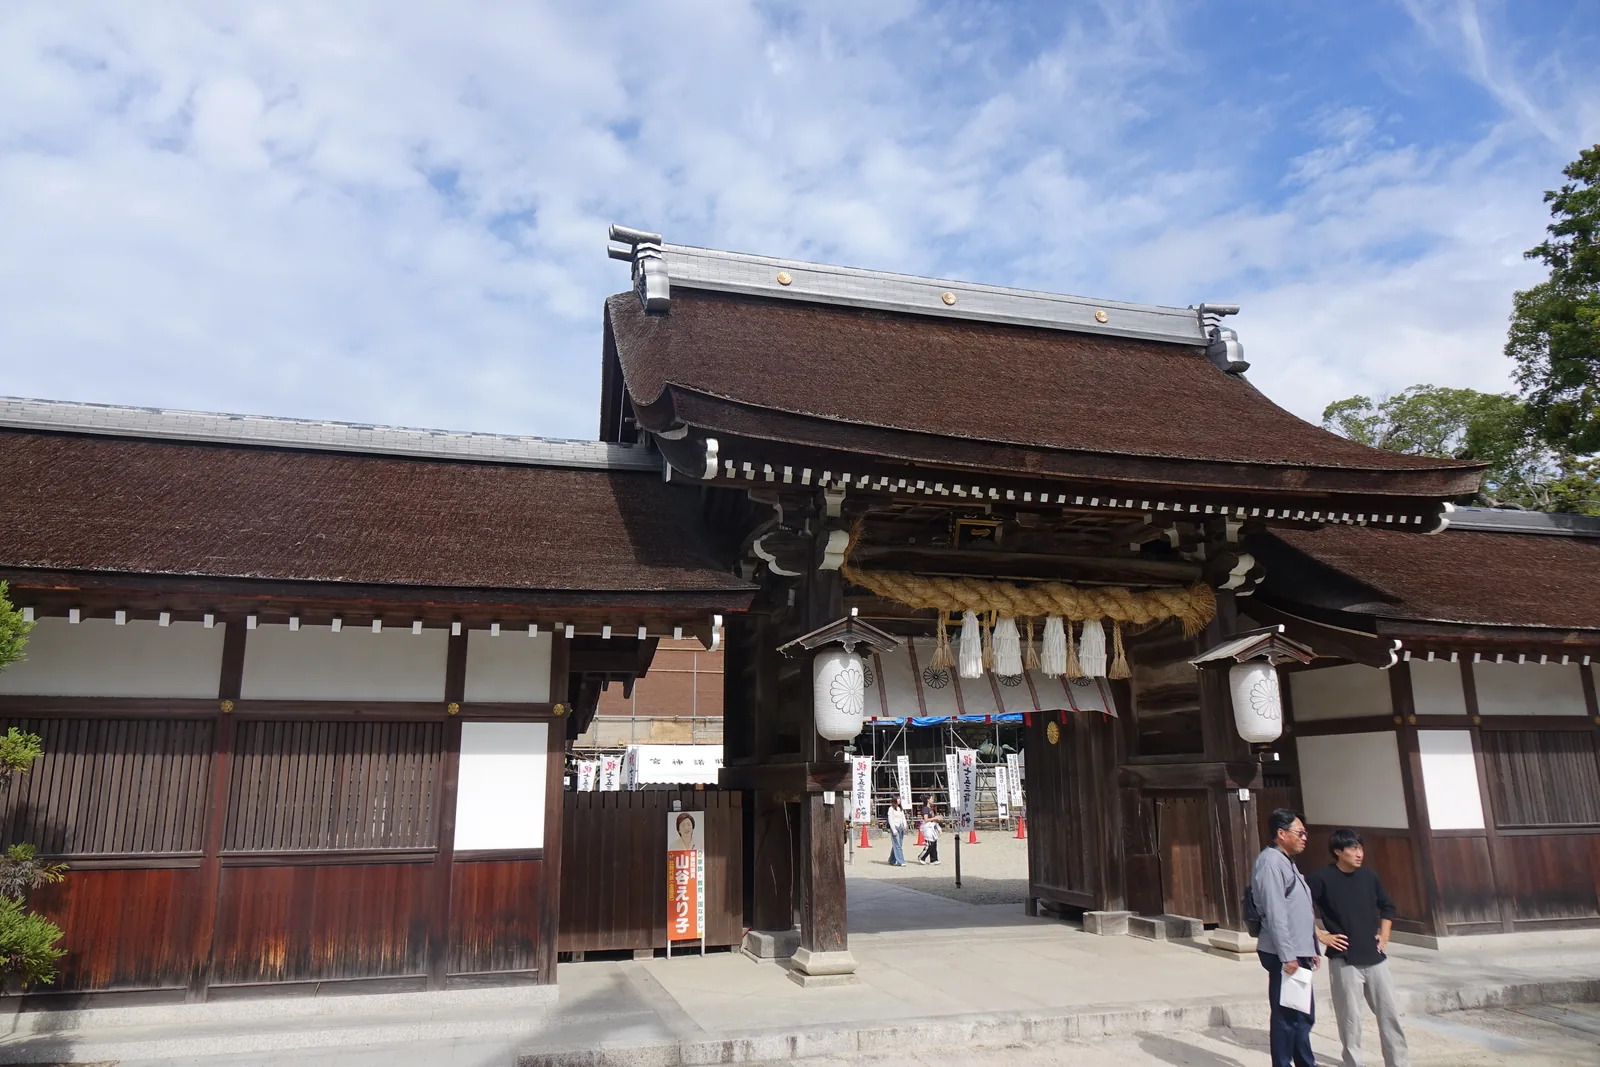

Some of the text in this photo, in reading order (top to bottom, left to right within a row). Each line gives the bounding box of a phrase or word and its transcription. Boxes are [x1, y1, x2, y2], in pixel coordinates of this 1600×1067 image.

[675, 855, 690, 933] 山谷えり子
